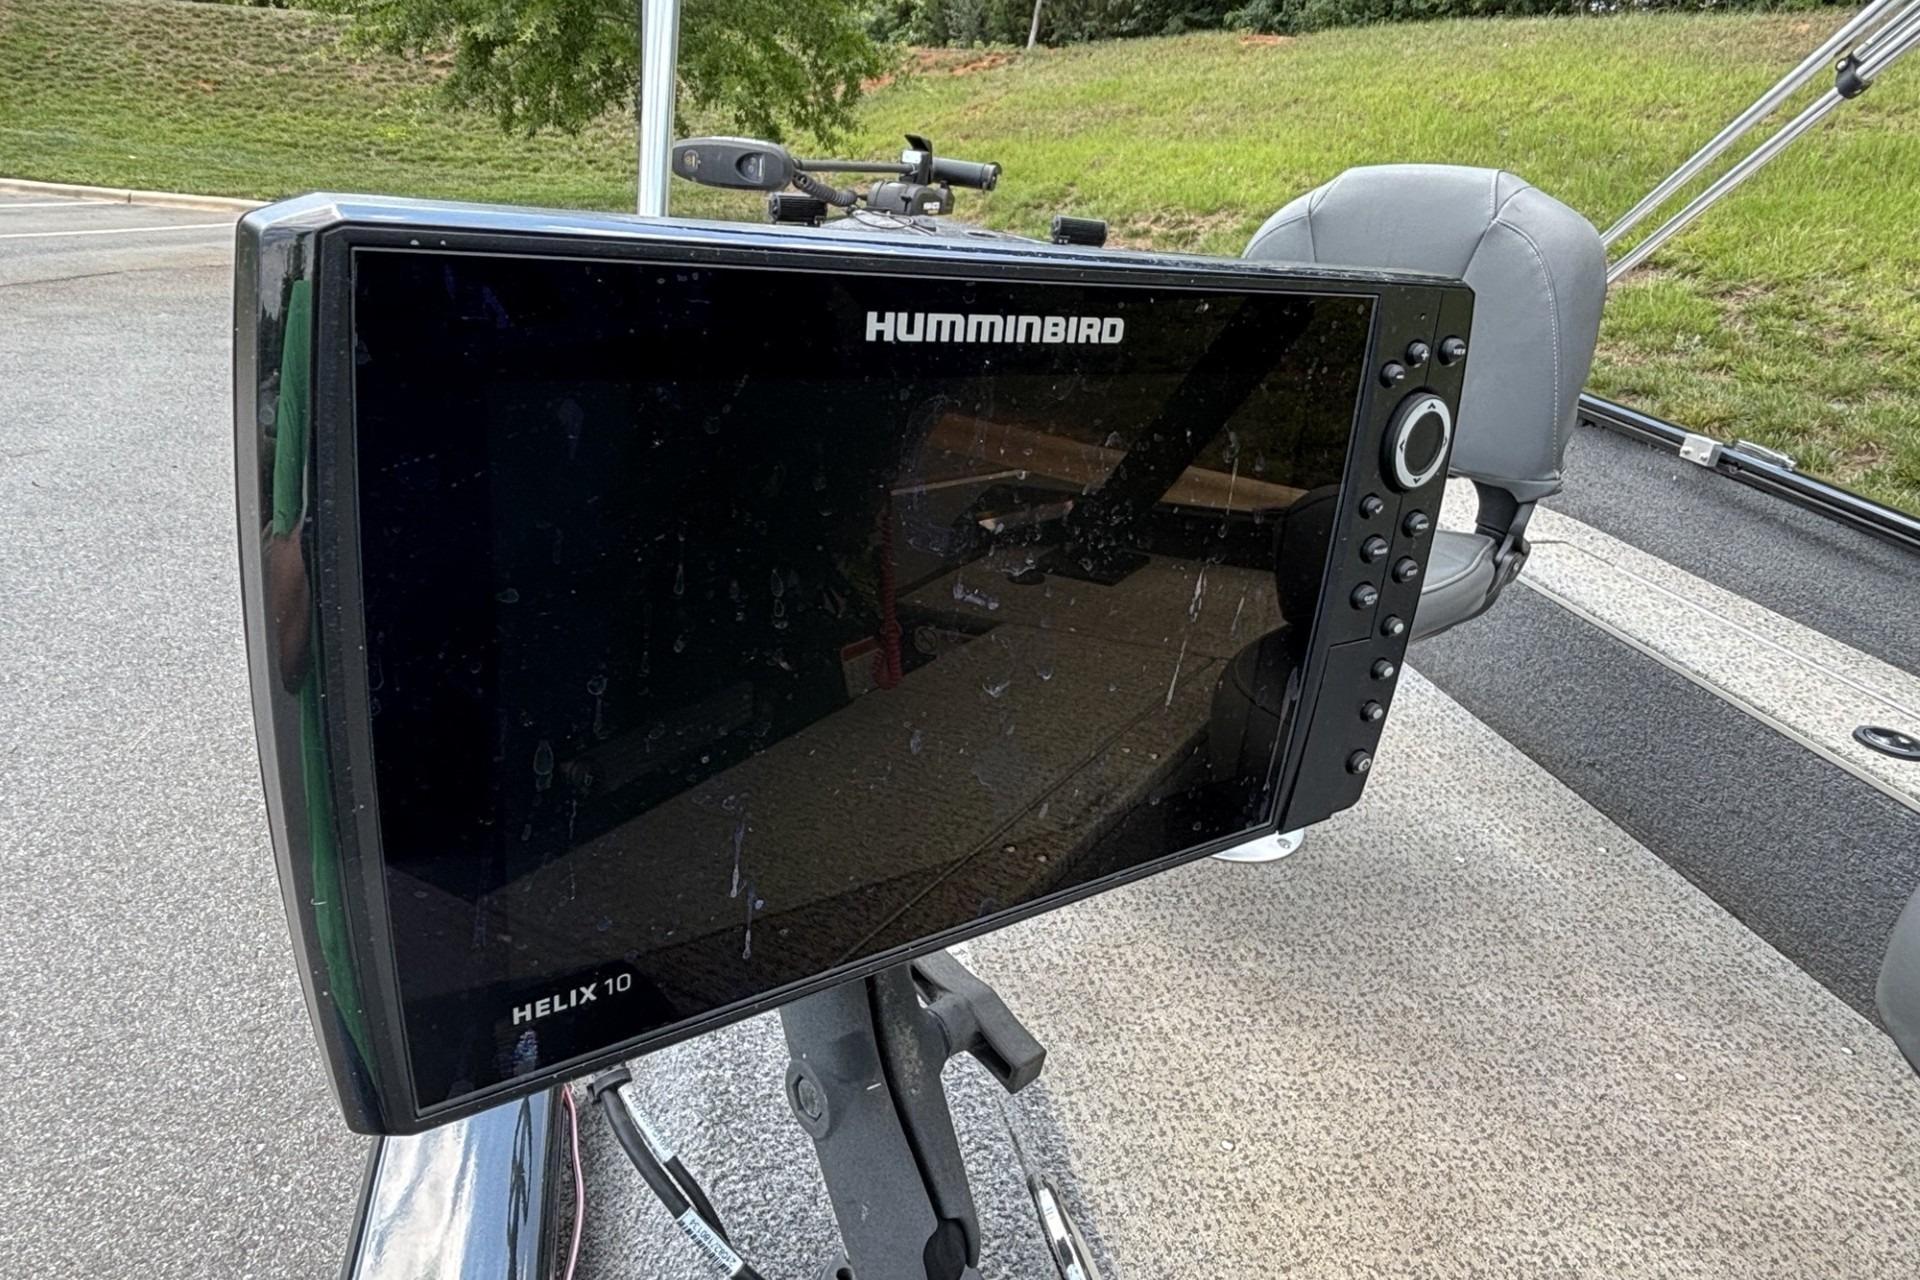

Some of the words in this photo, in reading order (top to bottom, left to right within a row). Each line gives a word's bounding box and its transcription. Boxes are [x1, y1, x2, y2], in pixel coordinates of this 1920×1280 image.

[865, 311, 1125, 344] HUMMINBIRD
[512, 982, 598, 1025] HELIX
[604, 973, 631, 995] 10
